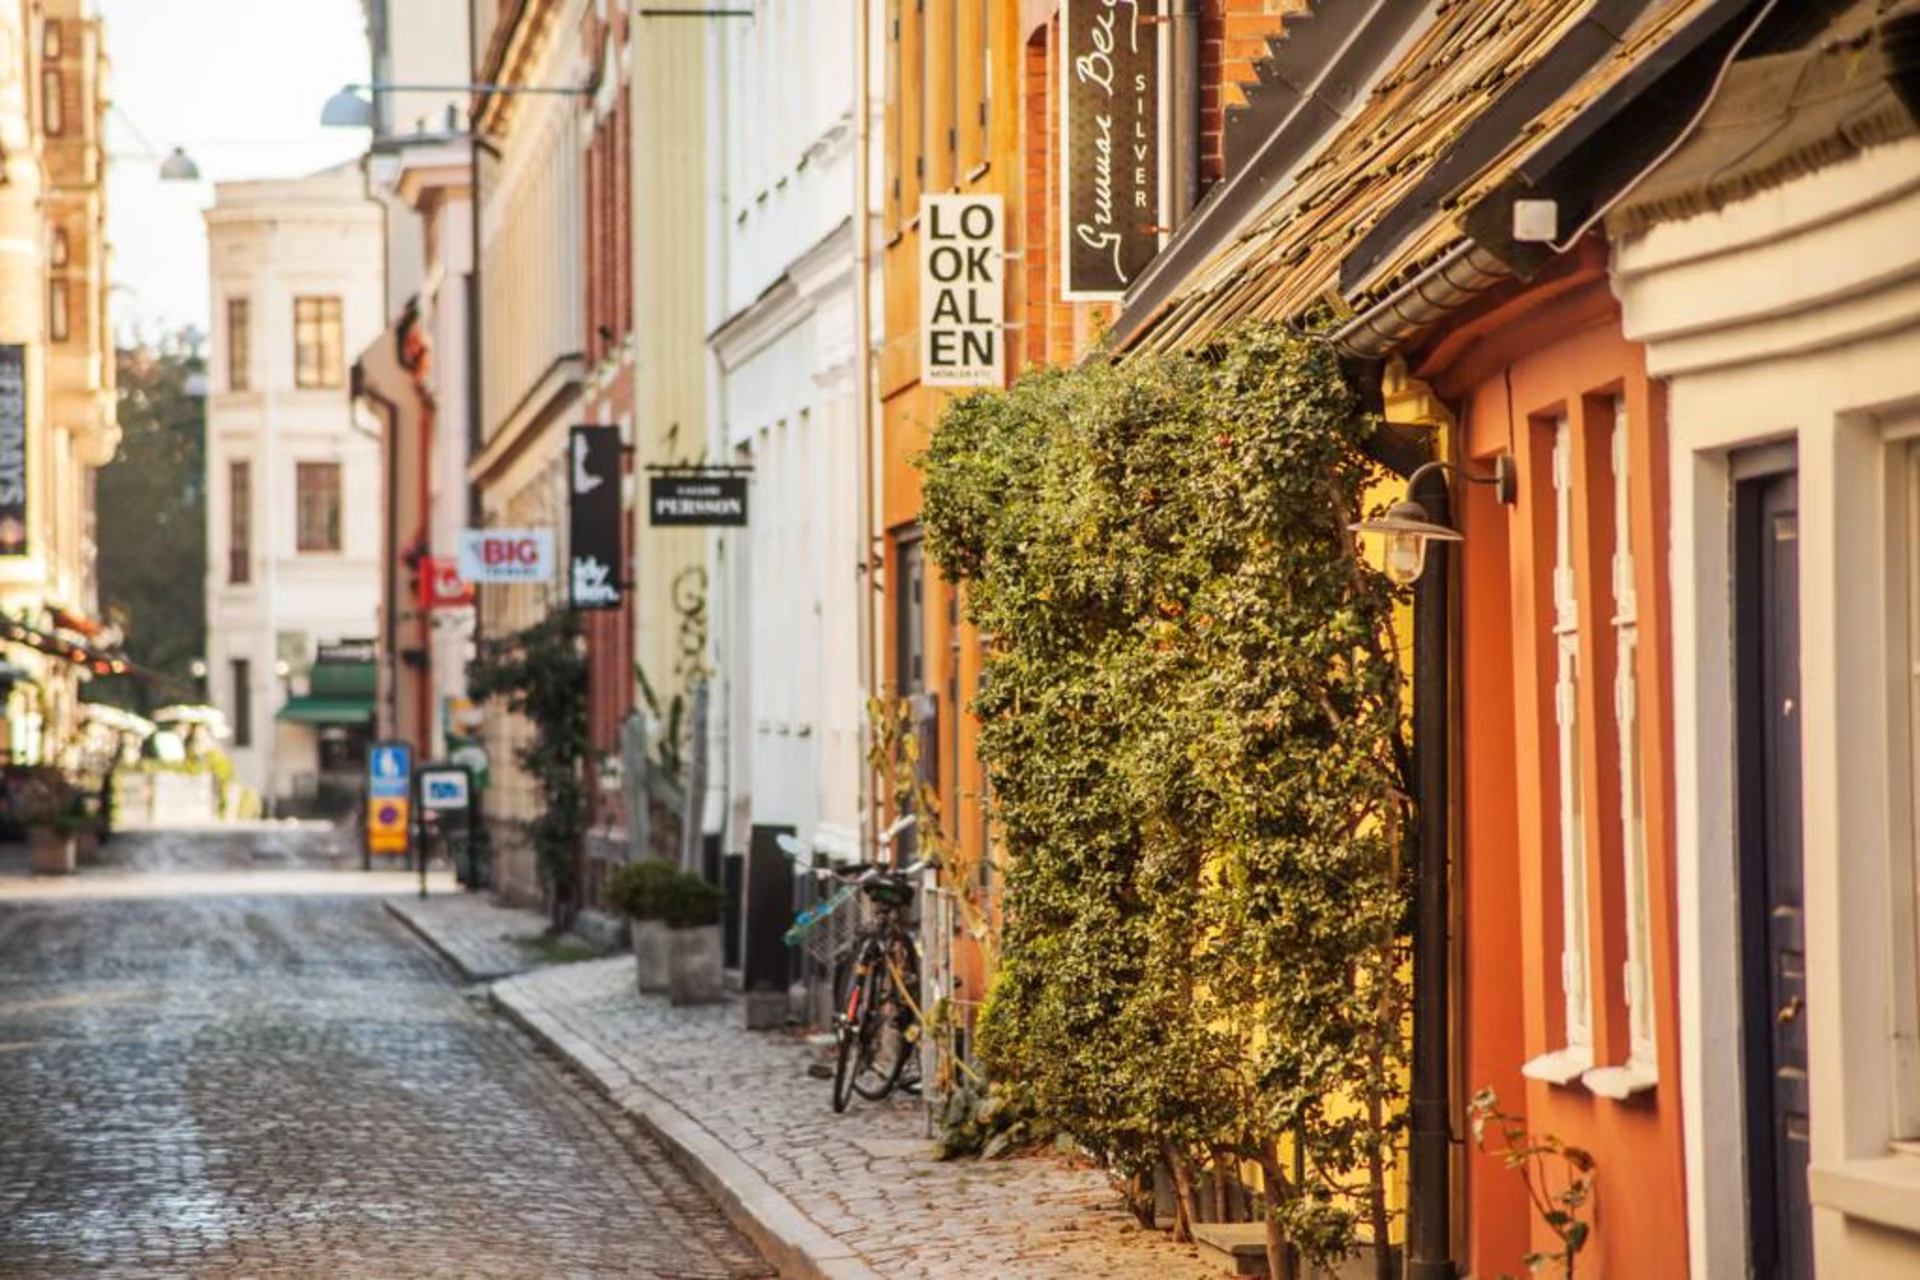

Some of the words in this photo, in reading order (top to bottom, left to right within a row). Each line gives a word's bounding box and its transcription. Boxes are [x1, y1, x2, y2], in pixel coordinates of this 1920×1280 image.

[1133, 74, 1147, 208] SILVER
[656, 498, 742, 515] PERSSON
[483, 539, 540, 566] BIG
